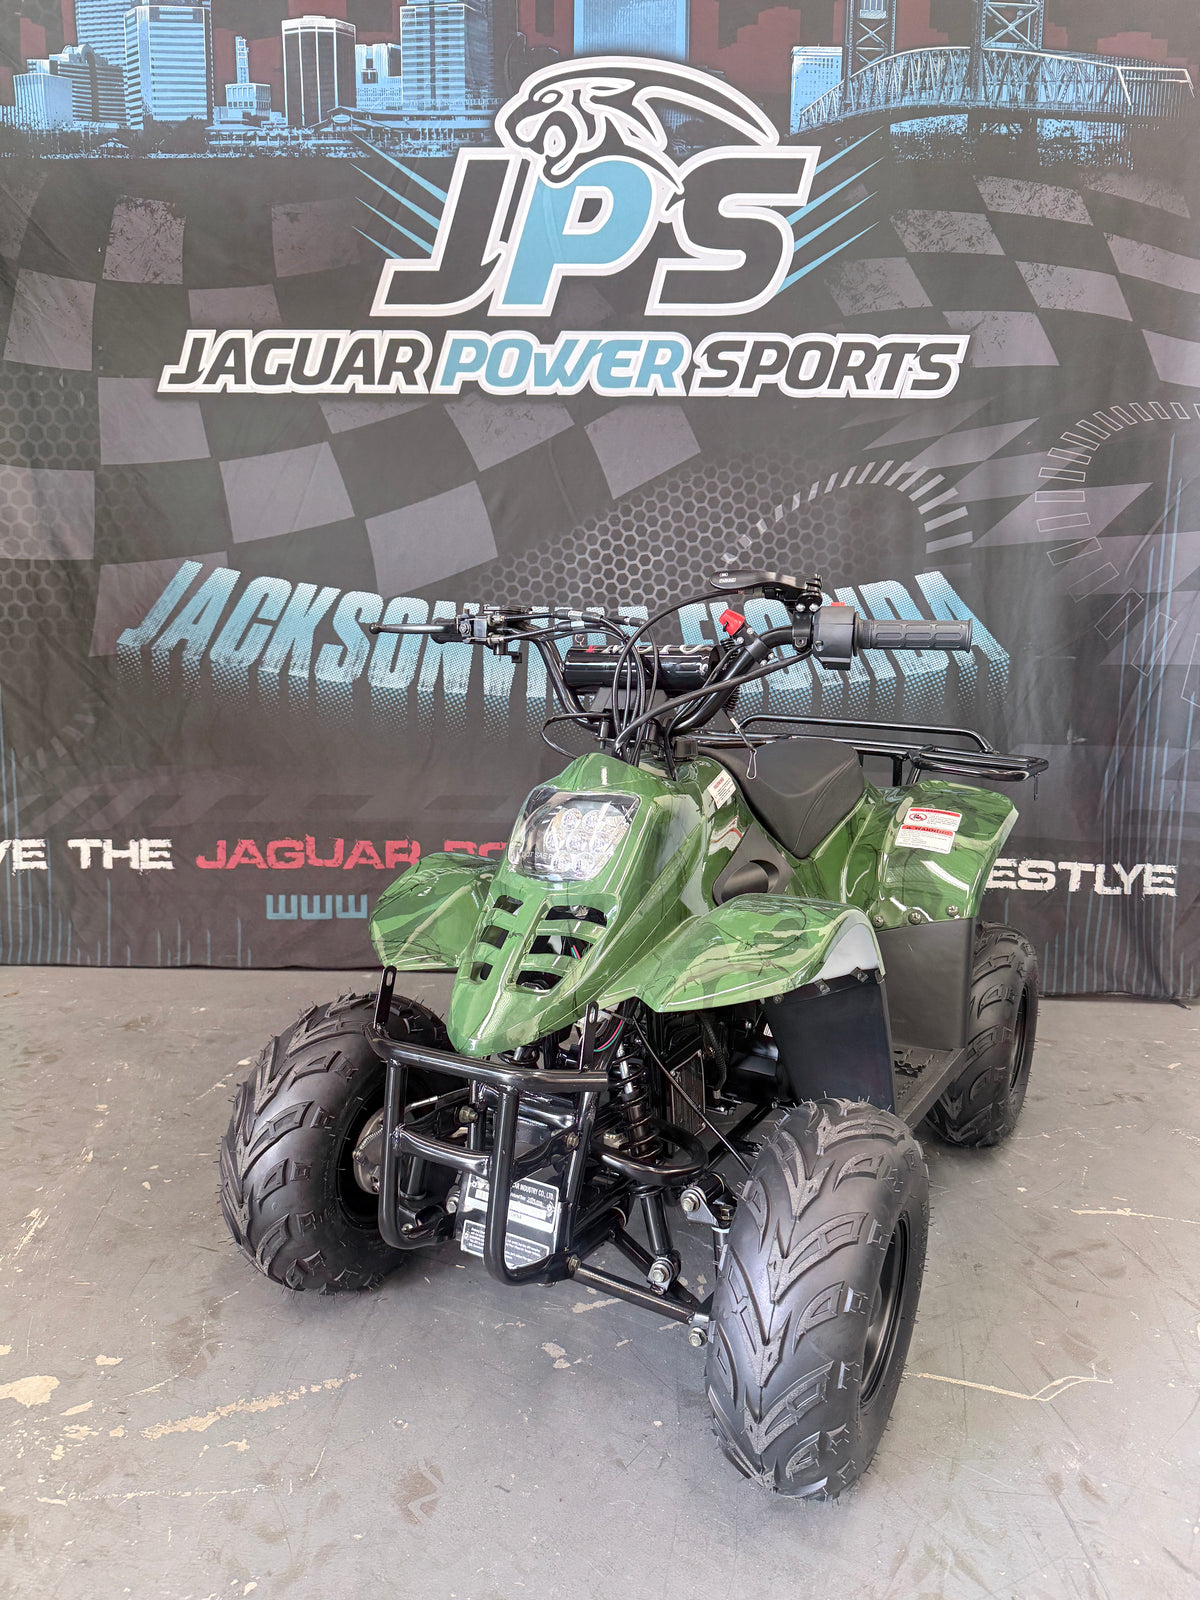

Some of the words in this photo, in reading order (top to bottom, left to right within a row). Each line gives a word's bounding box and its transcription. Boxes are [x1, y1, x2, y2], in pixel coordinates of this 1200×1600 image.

[373, 148, 818, 314] JPS
[160, 332, 430, 391] JAGUAR
[434, 333, 689, 393] POWER
[692, 334, 966, 396] SPORTS
[116, 560, 652, 702] JACKSONVI
[67, 838, 175, 871] THE
[195, 835, 421, 870] JAGUAR
